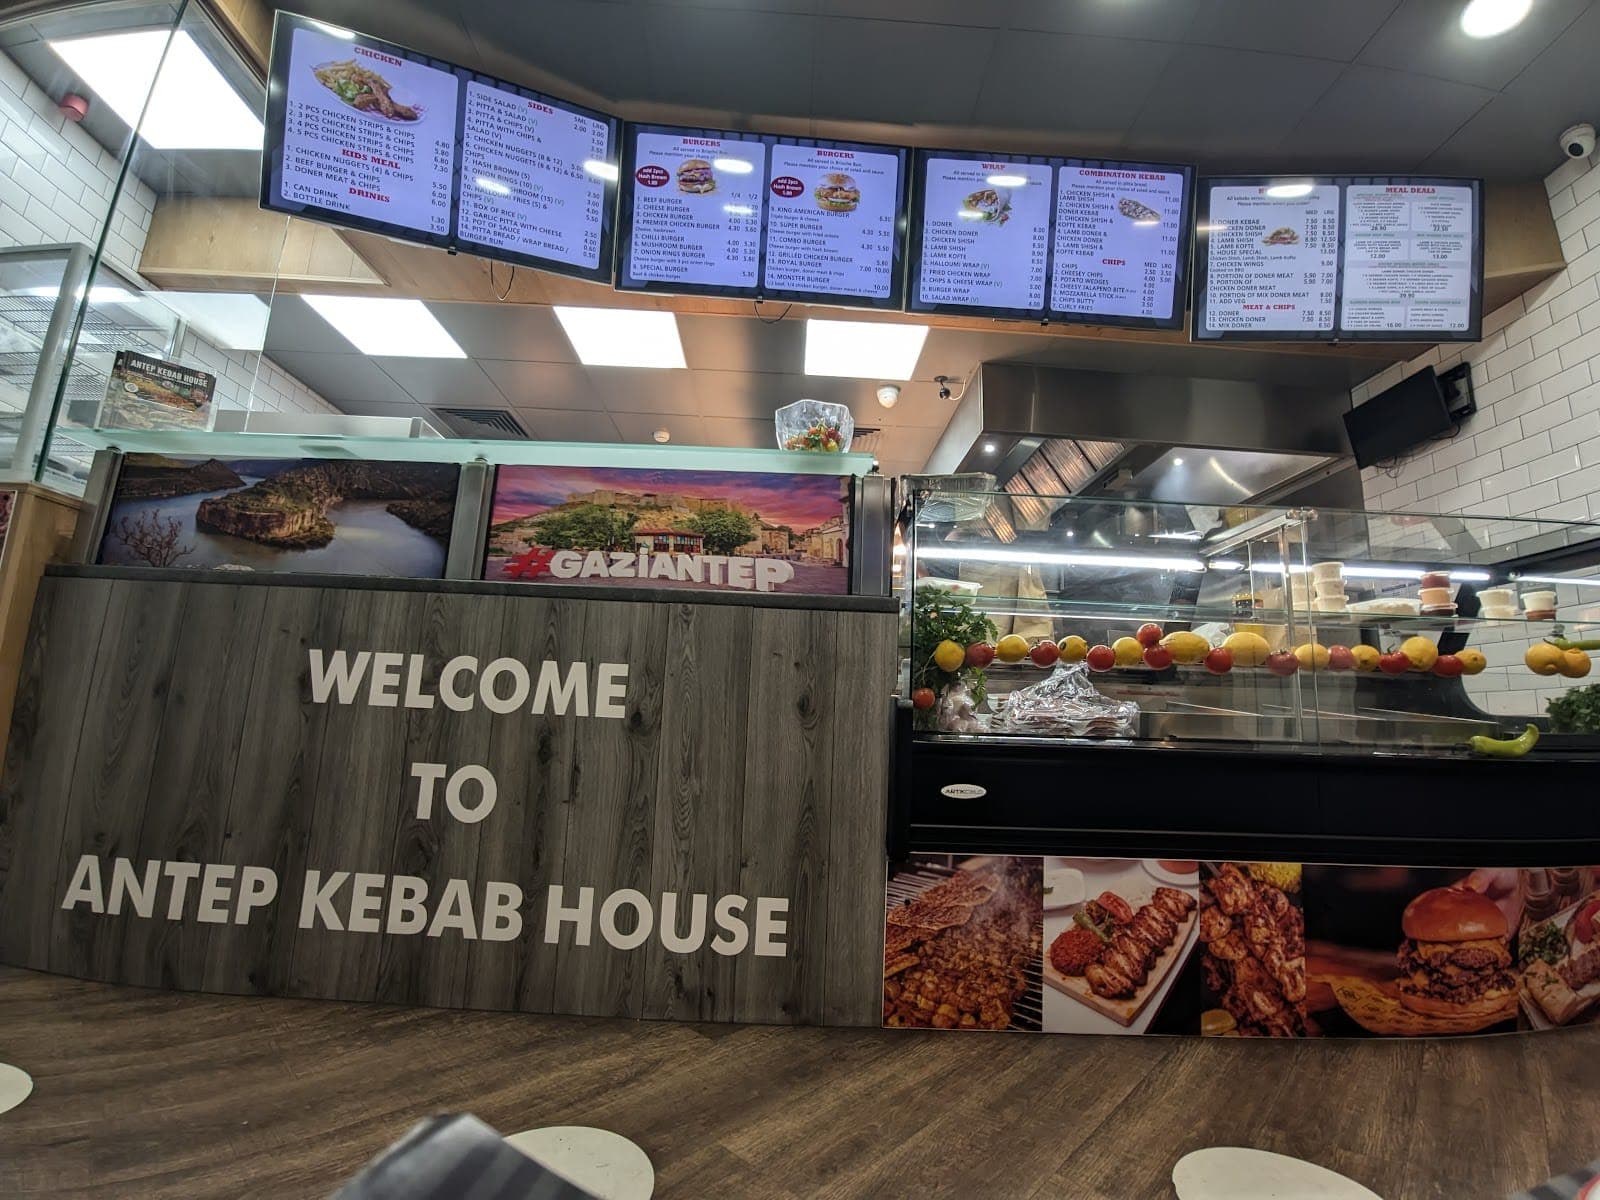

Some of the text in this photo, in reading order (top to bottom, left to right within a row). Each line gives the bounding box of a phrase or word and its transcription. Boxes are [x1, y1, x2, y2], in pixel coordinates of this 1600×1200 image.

[354, 46, 402, 66] CHICKEN
[476, 93, 491, 102] SIDE
[493, 98, 516, 109] SALAD
[527, 101, 553, 114] SIDES
[305, 104, 319, 114] PCS
[322, 109, 356, 124] CHICKEN
[358, 118, 384, 131] STRIPS
[394, 128, 415, 139] CHIPS
[475, 110, 494, 121] PITTA
[503, 118, 522, 129] CHIPS
[476, 102, 495, 113] PITTA
[504, 110, 526, 121] SALAD
[304, 122, 318, 131] PCS
[321, 126, 355, 140] CHICKEN
[357, 135, 382, 147] STRIPS
[393, 145, 414, 156] CHIPS
[305, 113, 319, 122] PCS
[321, 117, 356, 132] CHICKEN
[358, 127, 383, 139] STRIPS
[393, 136, 414, 147] CHIPS
[475, 119, 534, 140] PITTA WITH CHIPS
[474, 135, 536, 158] CHICKEN NUGGETS
[682, 138, 720, 146] BURGERS
[342, 148, 400, 169] KIDS MEAL
[473, 143, 503, 157] CHICKEN
[504, 153, 535, 166] NUGGETS
[816, 150, 854, 158] BURGERS
[295, 147, 330, 161] CHICKEN
[333, 156, 369, 171] NUGGETS
[392, 171, 413, 182] CHIPS
[295, 156, 380, 183] BEEF BURGER CHIPS
[1079, 169, 1136, 178] COMBINATION
[294, 165, 380, 192] DONER MEAT CHIPS
[432, 181, 446, 190] 5.50
[472, 168, 495, 179] ONION
[497, 174, 517, 184] RINGS
[293, 183, 338, 199] CAN DRINK
[293, 191, 349, 210] BOTTLE DRINK
[349, 187, 389, 203] DRINKS
[432, 190, 446, 199] 6.00
[512, 196, 530, 205] FRIES
[431, 198, 445, 207] 6.00
[473, 202, 488, 211] BOX
[501, 209, 515, 218] RICE
[473, 211, 561, 237] GARLIC PITTA WITH CHEESE
[472, 225, 490, 235] PITTA
[492, 230, 515, 240] BREAD
[522, 237, 541, 246] WRAP
[130, 360, 156, 372] ANTEP
[158, 367, 182, 380] KEBAB
[184, 375, 208, 387] HOUSE
[308, 648, 629, 719] WELCOME
[411, 762, 498, 824] TO
[61, 854, 789, 958] ANTEP KEBAB HOUSE
